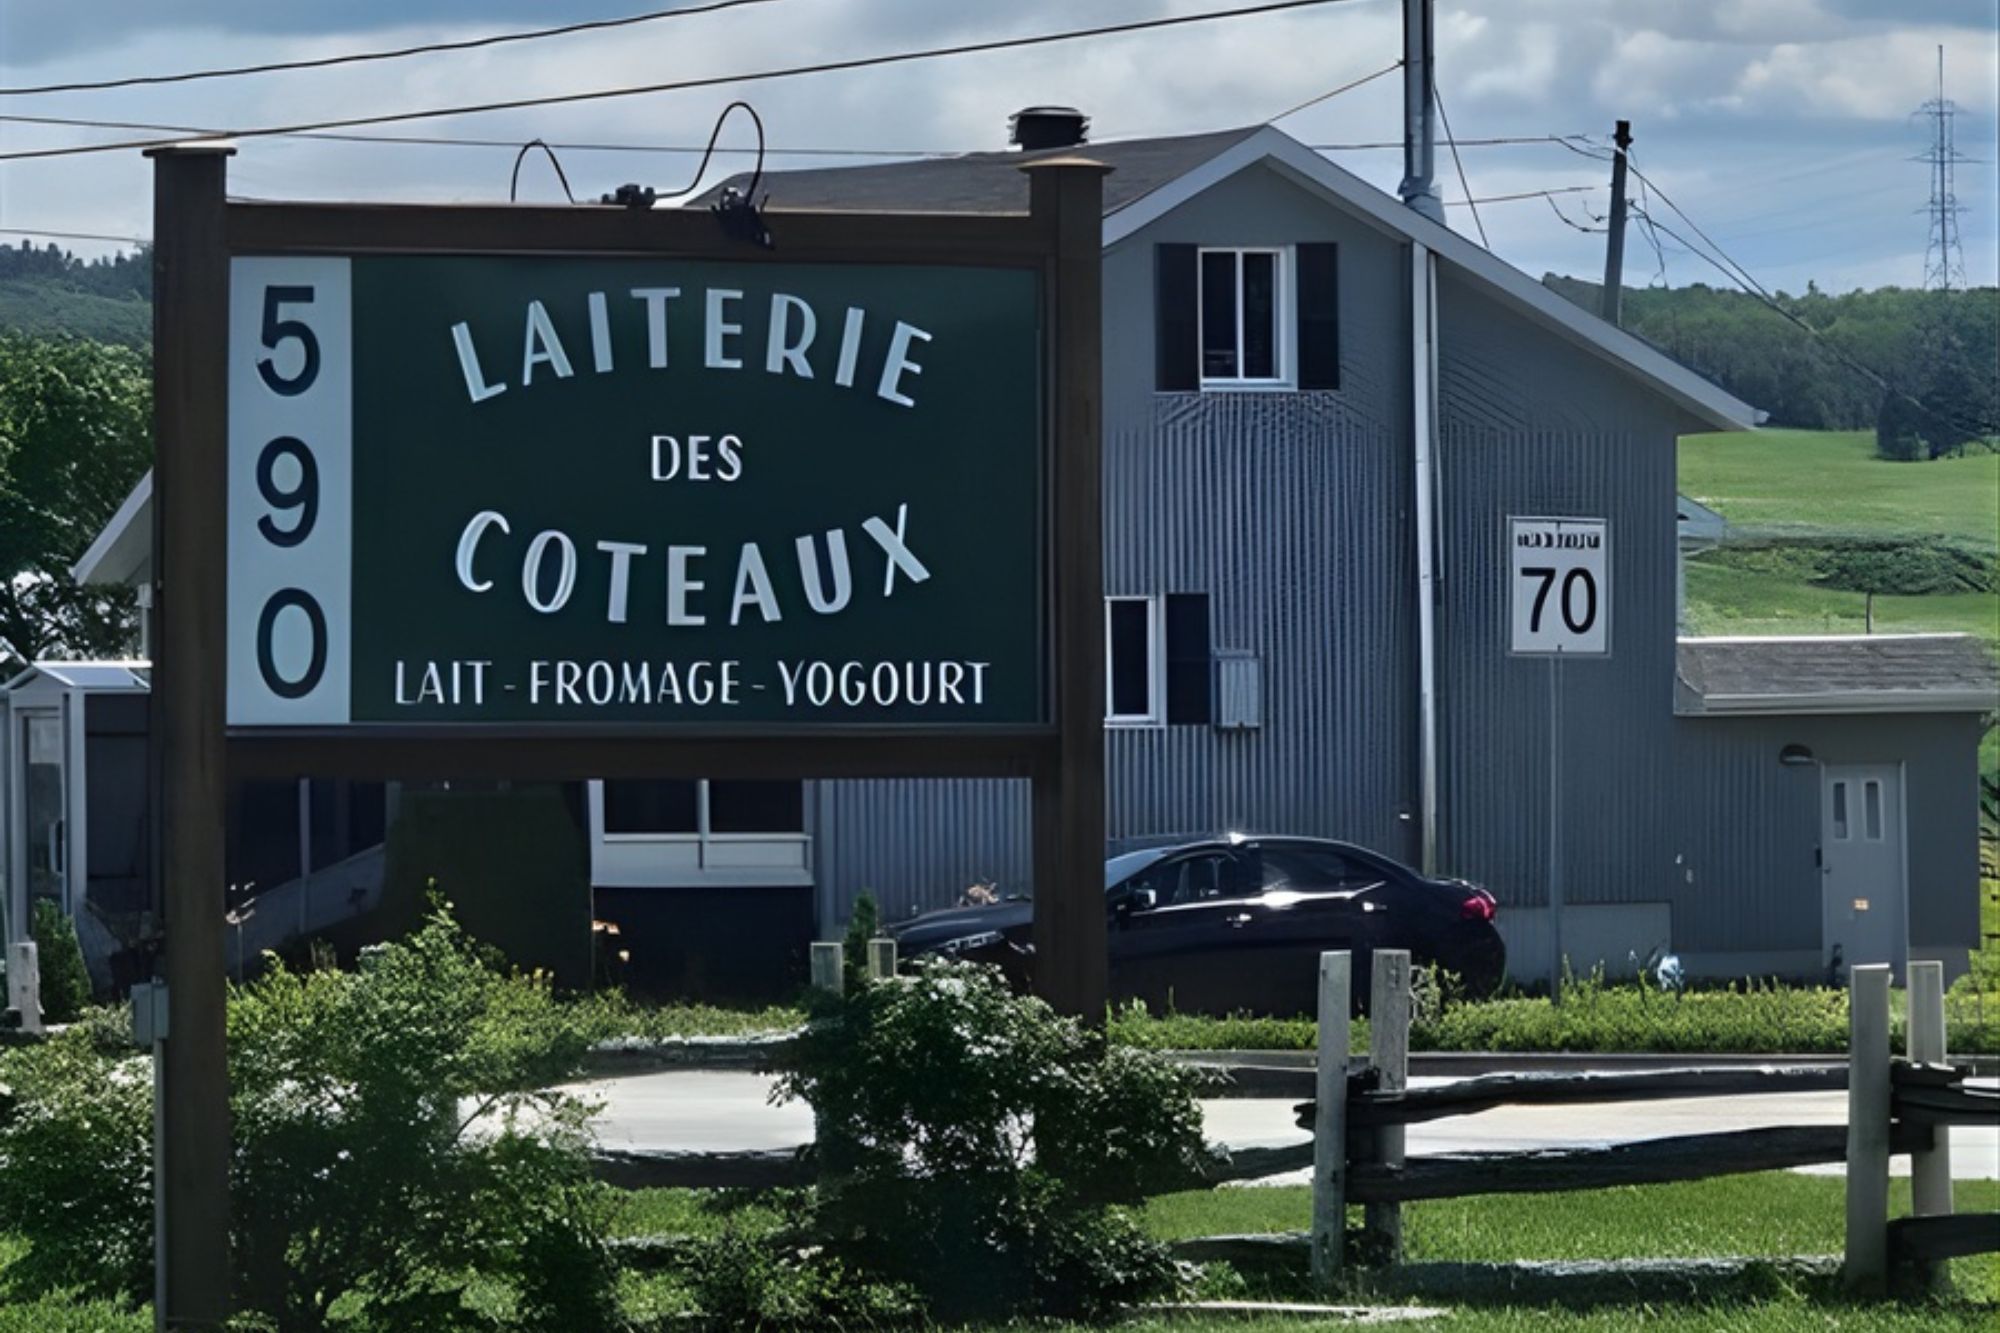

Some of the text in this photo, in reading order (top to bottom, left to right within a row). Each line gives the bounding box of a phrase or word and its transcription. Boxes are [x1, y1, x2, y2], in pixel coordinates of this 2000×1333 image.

[451, 288, 933, 407] LAITERIE
[255, 283, 329, 700] 590
[651, 435, 743, 482] DES
[455, 503, 931, 627] COTEAUX
[1520, 566, 1597, 635] 70
[395, 660, 492, 705] LAIT
[530, 660, 739, 706] FROMAGE
[777, 660, 990, 707] YOGOURT
